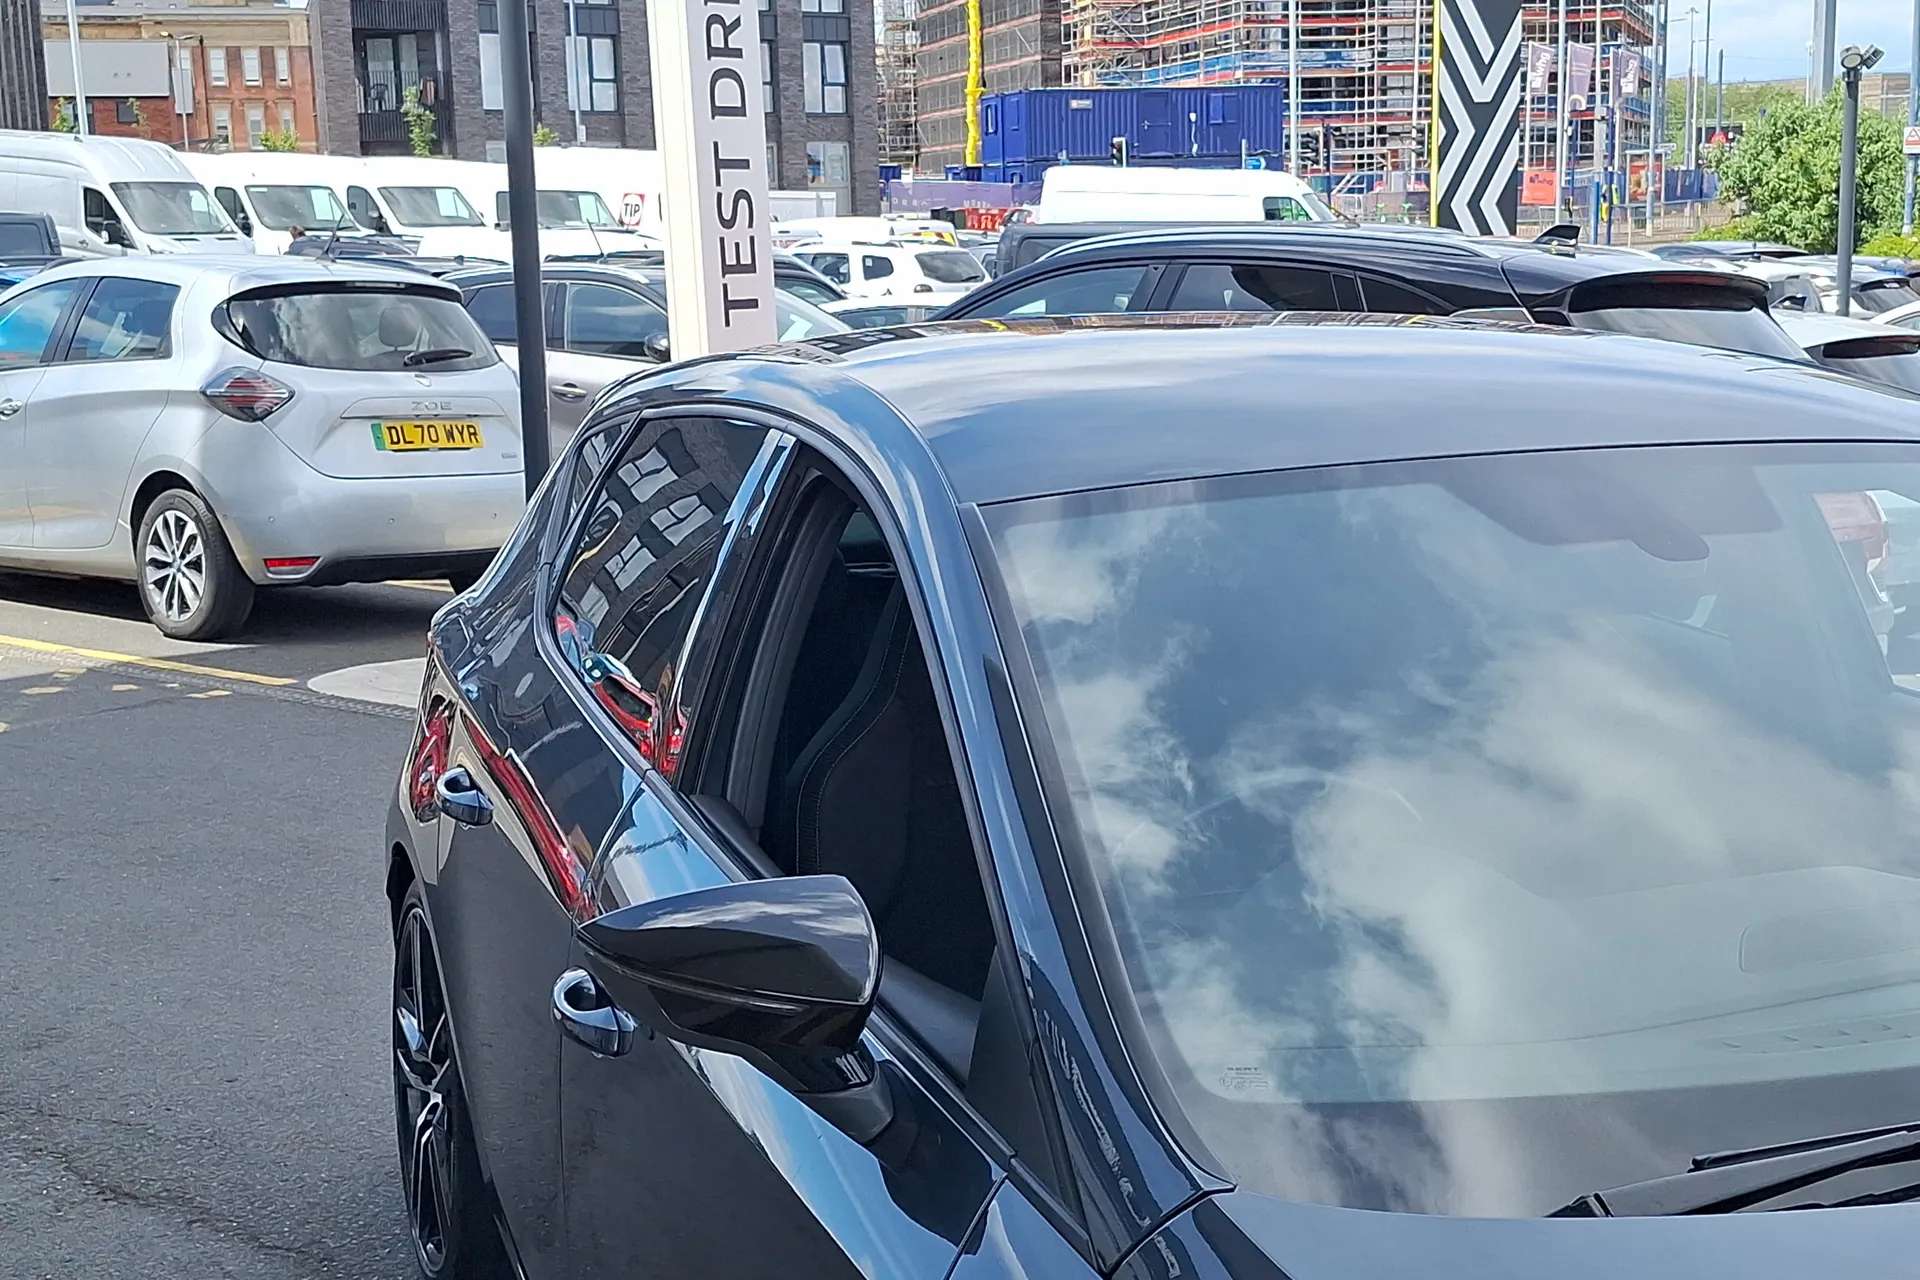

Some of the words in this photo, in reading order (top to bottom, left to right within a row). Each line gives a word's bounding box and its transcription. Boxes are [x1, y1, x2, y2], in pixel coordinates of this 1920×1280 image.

[623, 203, 641, 217] TIP
[713, 141, 759, 328] TEST
[411, 401, 452, 411] ZOE
[386, 425, 440, 446] DL70
[445, 424, 479, 444] WYR
